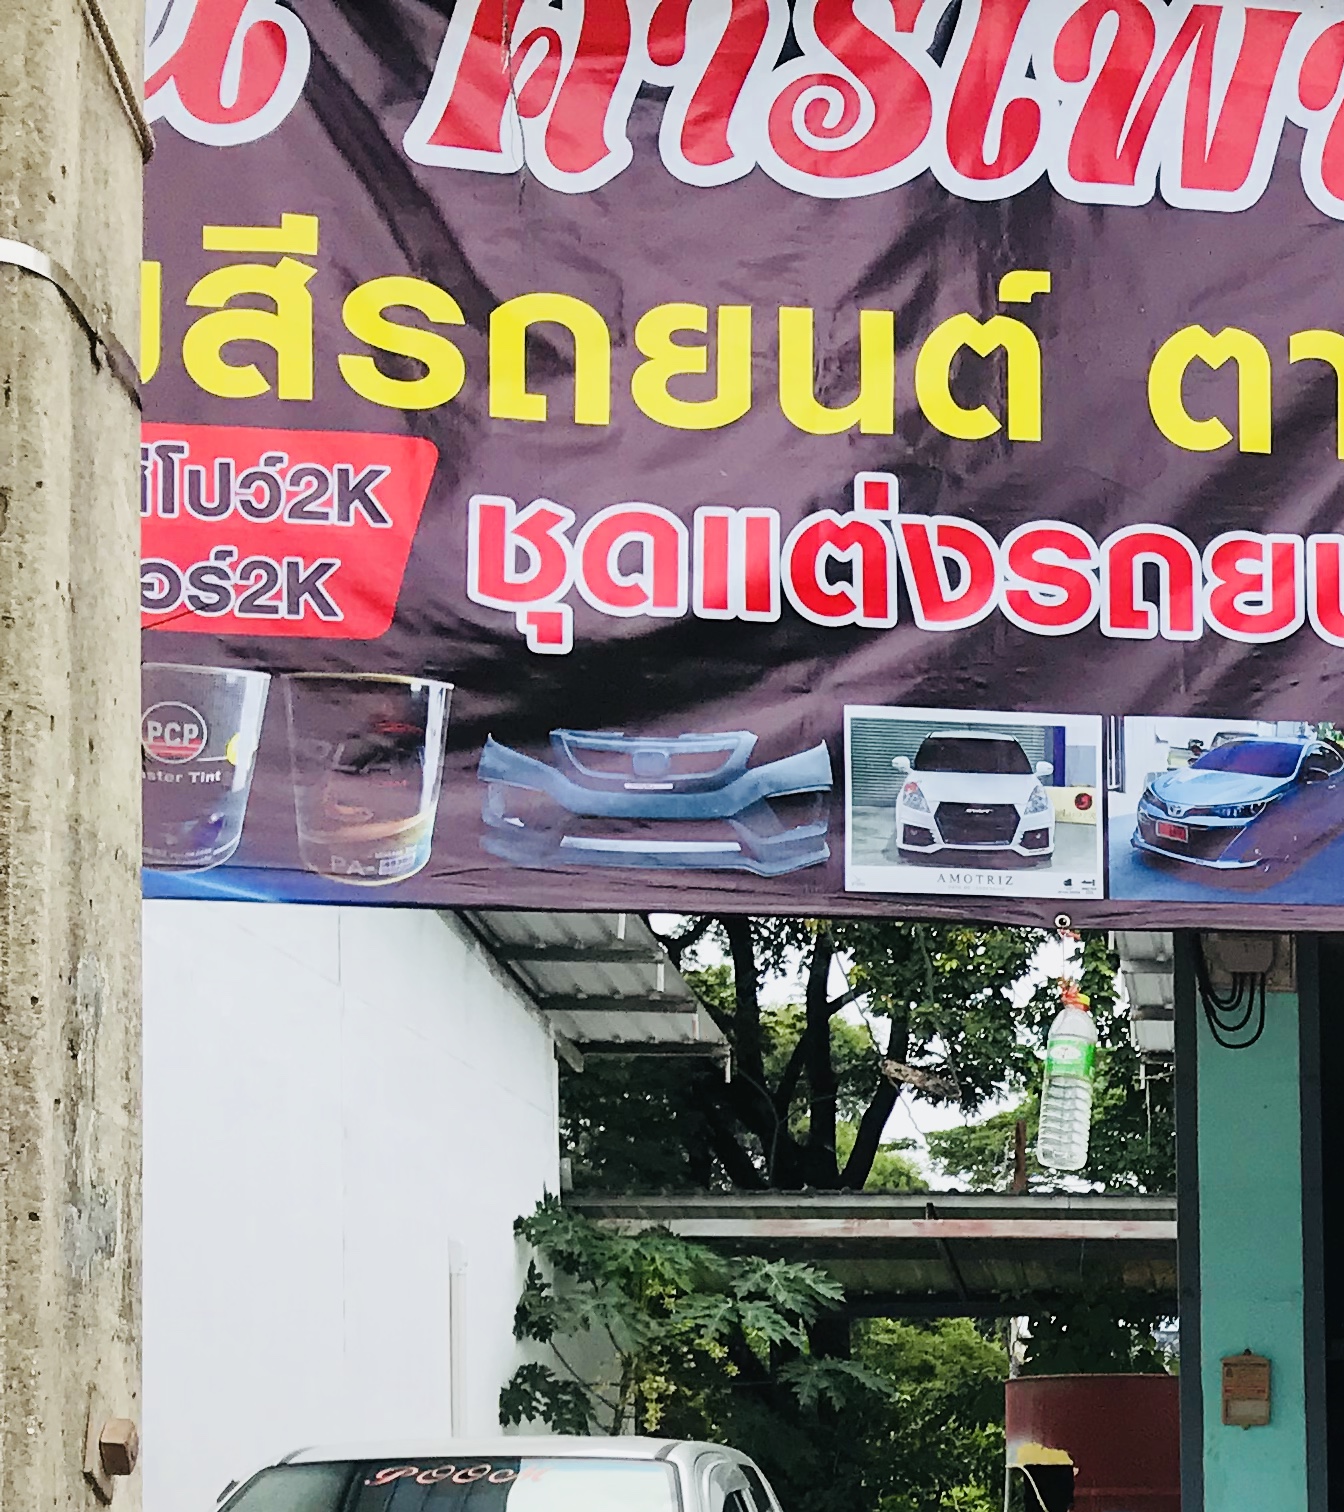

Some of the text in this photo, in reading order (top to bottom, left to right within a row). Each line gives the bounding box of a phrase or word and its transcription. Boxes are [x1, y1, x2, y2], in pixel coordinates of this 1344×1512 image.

[141, 213, 1052, 444] สีรถยนต์
[141, 440, 393, 528] โปว์2K
[147, 720, 199, 747] PCP
[937, 874, 1014, 886] AMOTRIZ
